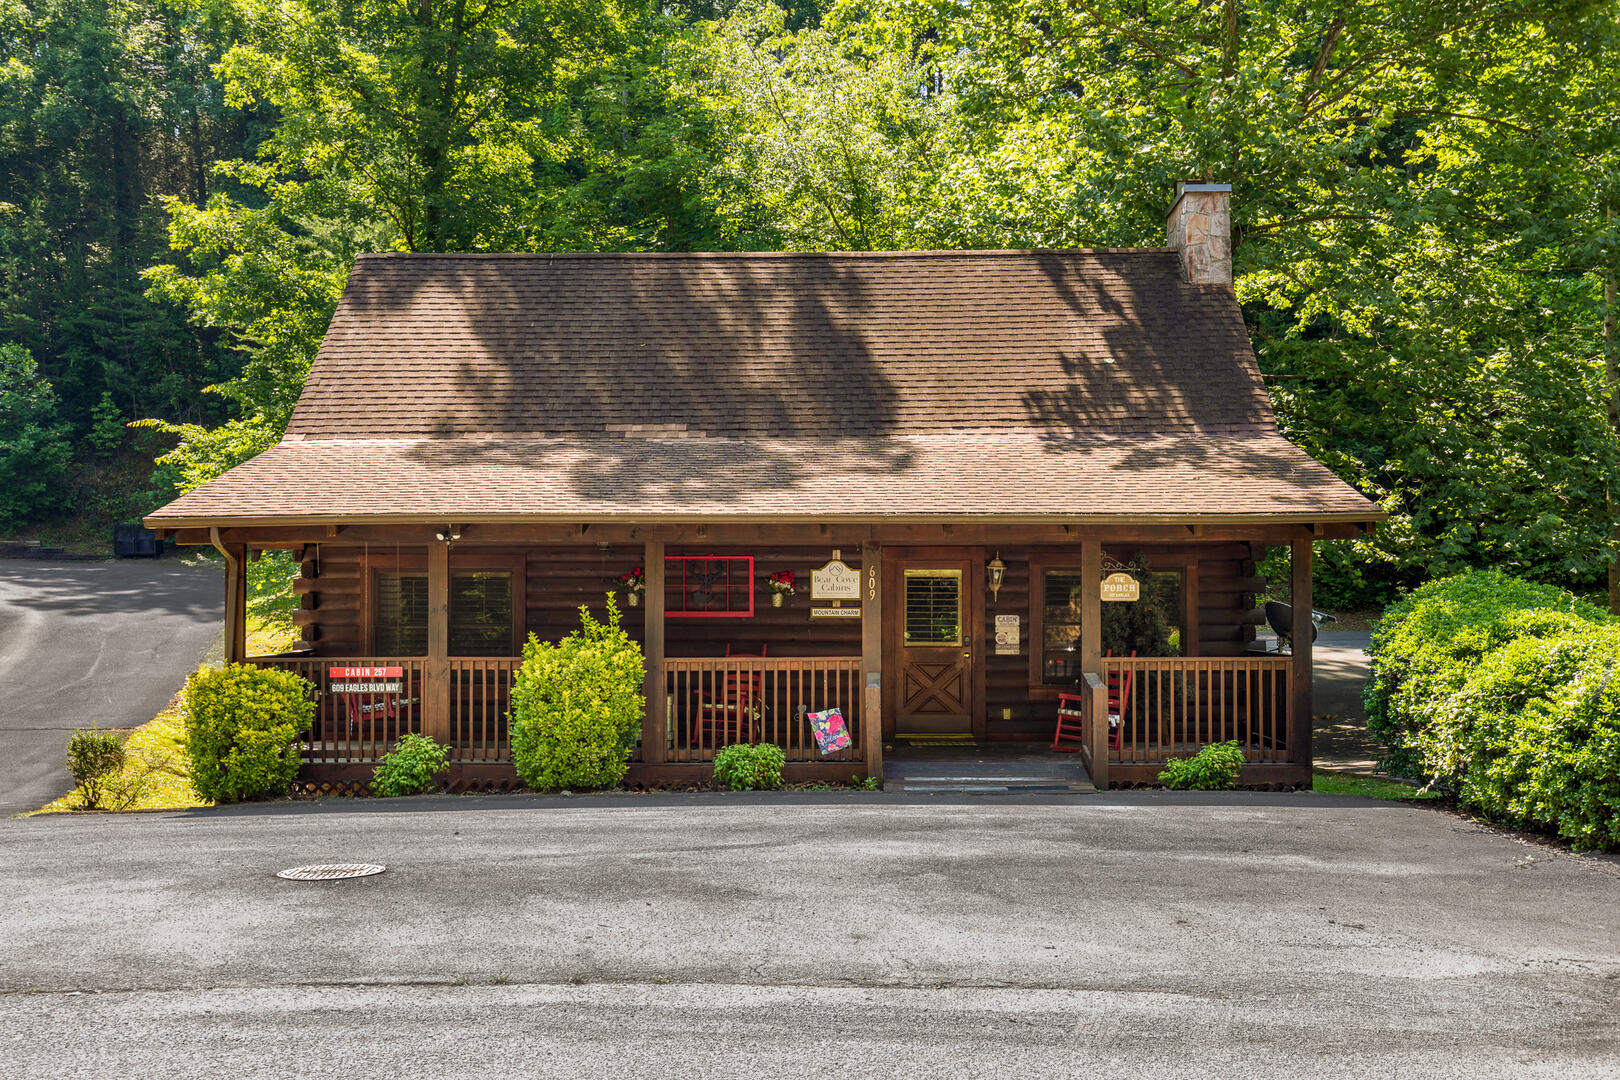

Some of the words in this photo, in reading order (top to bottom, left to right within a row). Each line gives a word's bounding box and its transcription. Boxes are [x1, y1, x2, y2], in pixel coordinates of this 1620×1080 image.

[814, 575, 831, 583] Bear
[836, 575, 858, 583] Cove
[868, 565, 876, 600] 609
[821, 583, 851, 591] Cabins
[1104, 584, 1136, 592] PORCH
[345, 668, 370, 676] CABIN
[374, 668, 386, 676] 257
[331, 684, 344, 692] 609
[345, 683, 368, 692] EAGLES
[369, 683, 385, 692] BLVD
[385, 683, 400, 692] WAY
